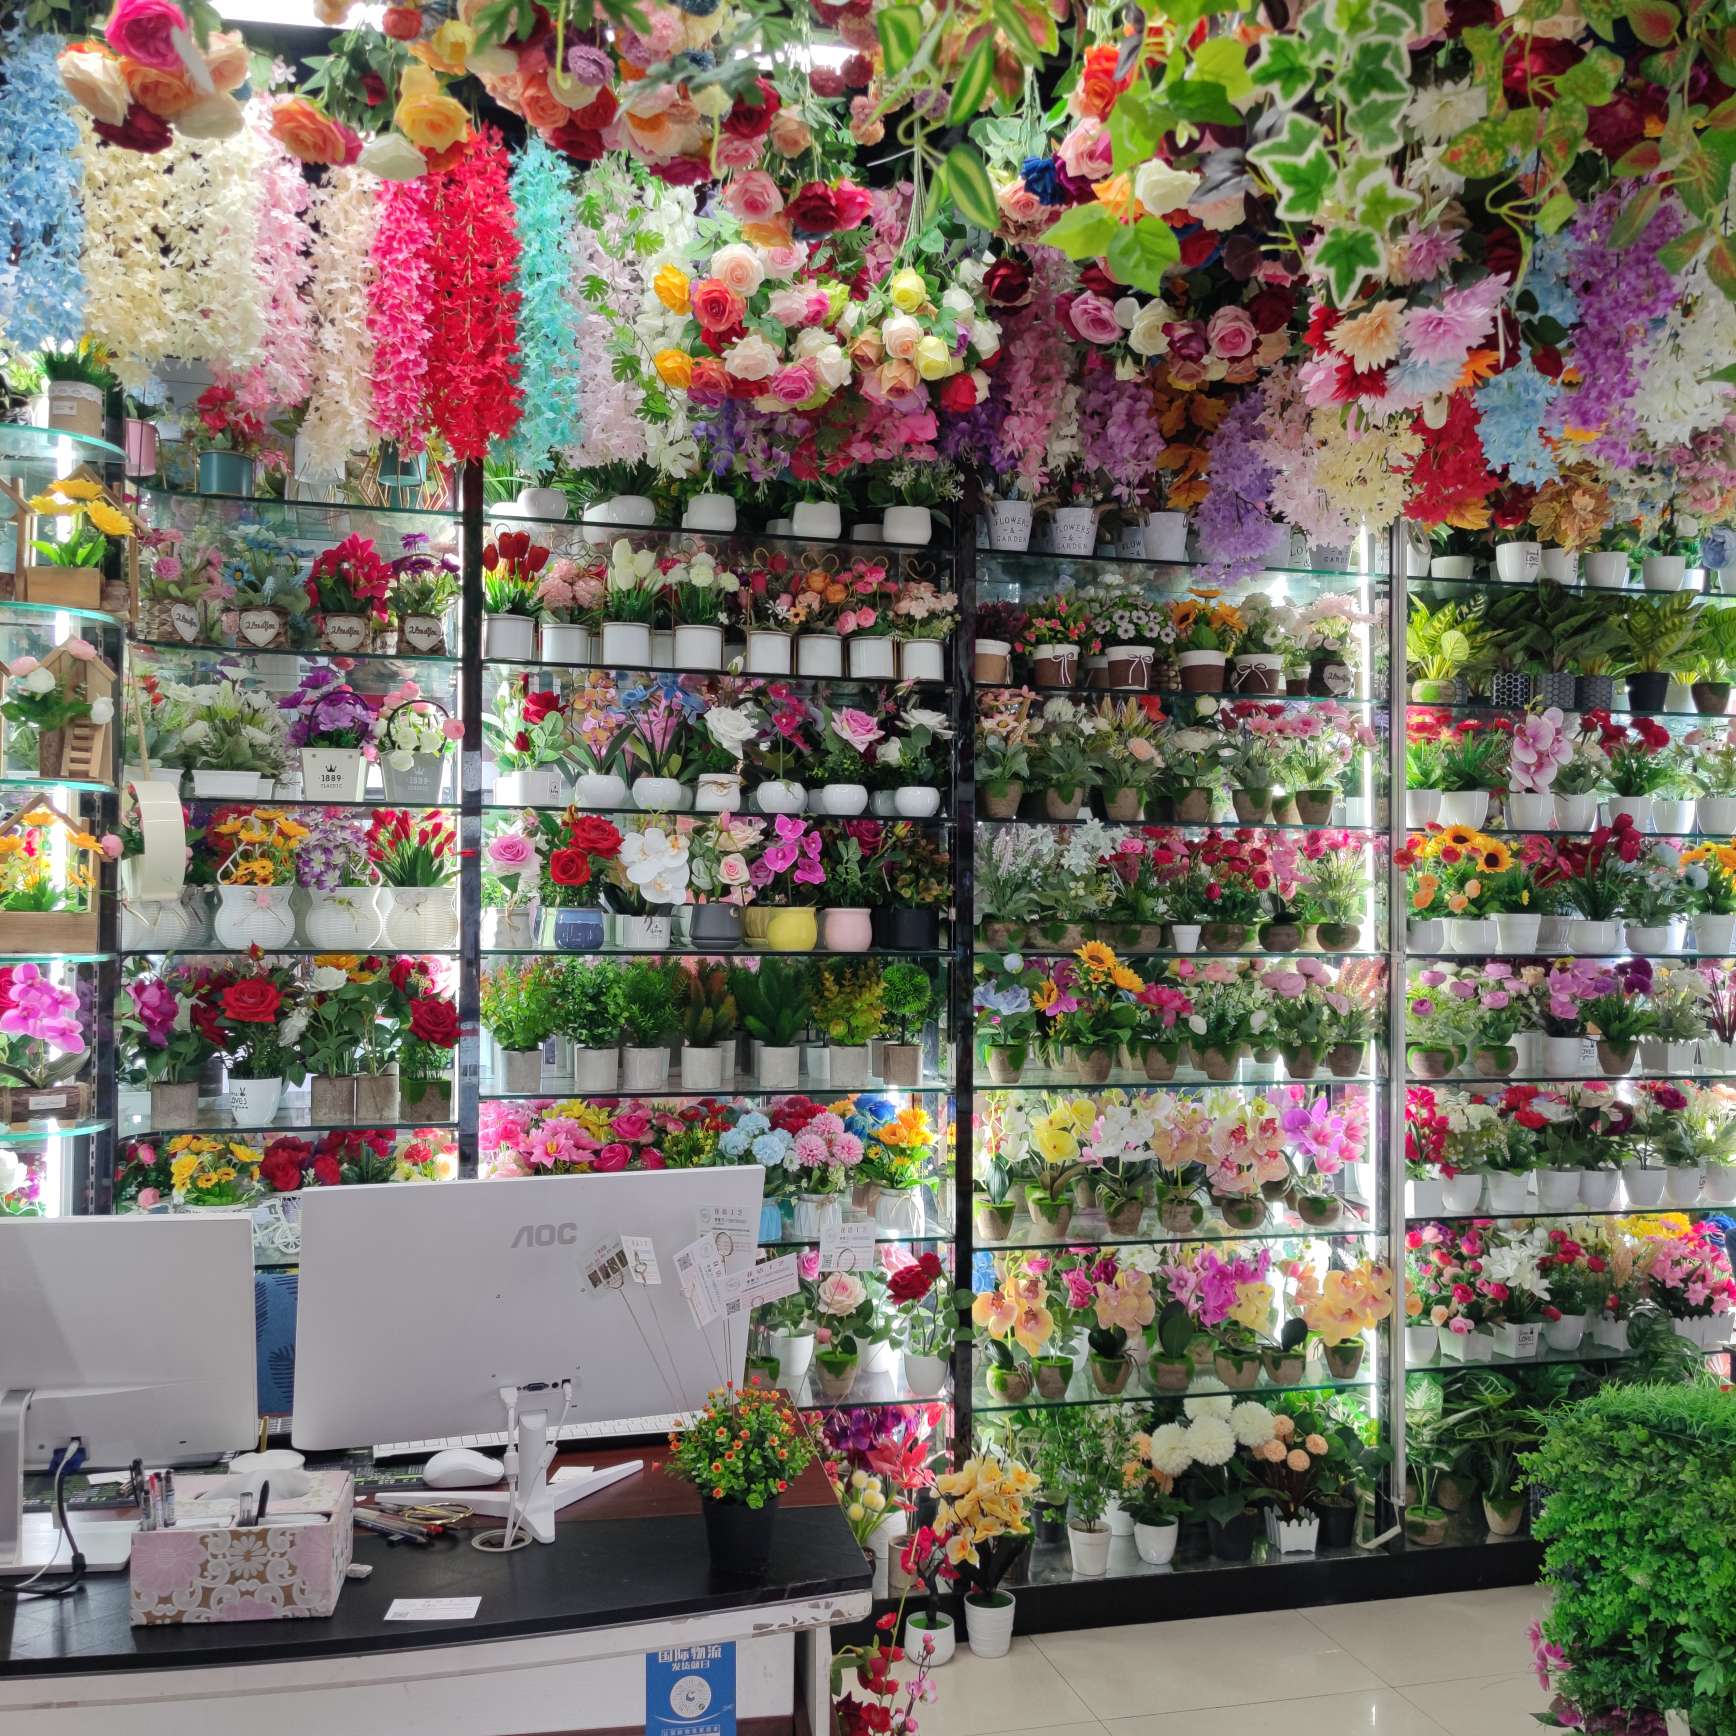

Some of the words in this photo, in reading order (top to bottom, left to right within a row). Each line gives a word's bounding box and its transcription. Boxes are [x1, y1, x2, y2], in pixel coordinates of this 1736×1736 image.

[321, 774, 342, 782] 1889
[511, 1222, 577, 1248] AOC
[658, 1645, 721, 1663] 国际物流
